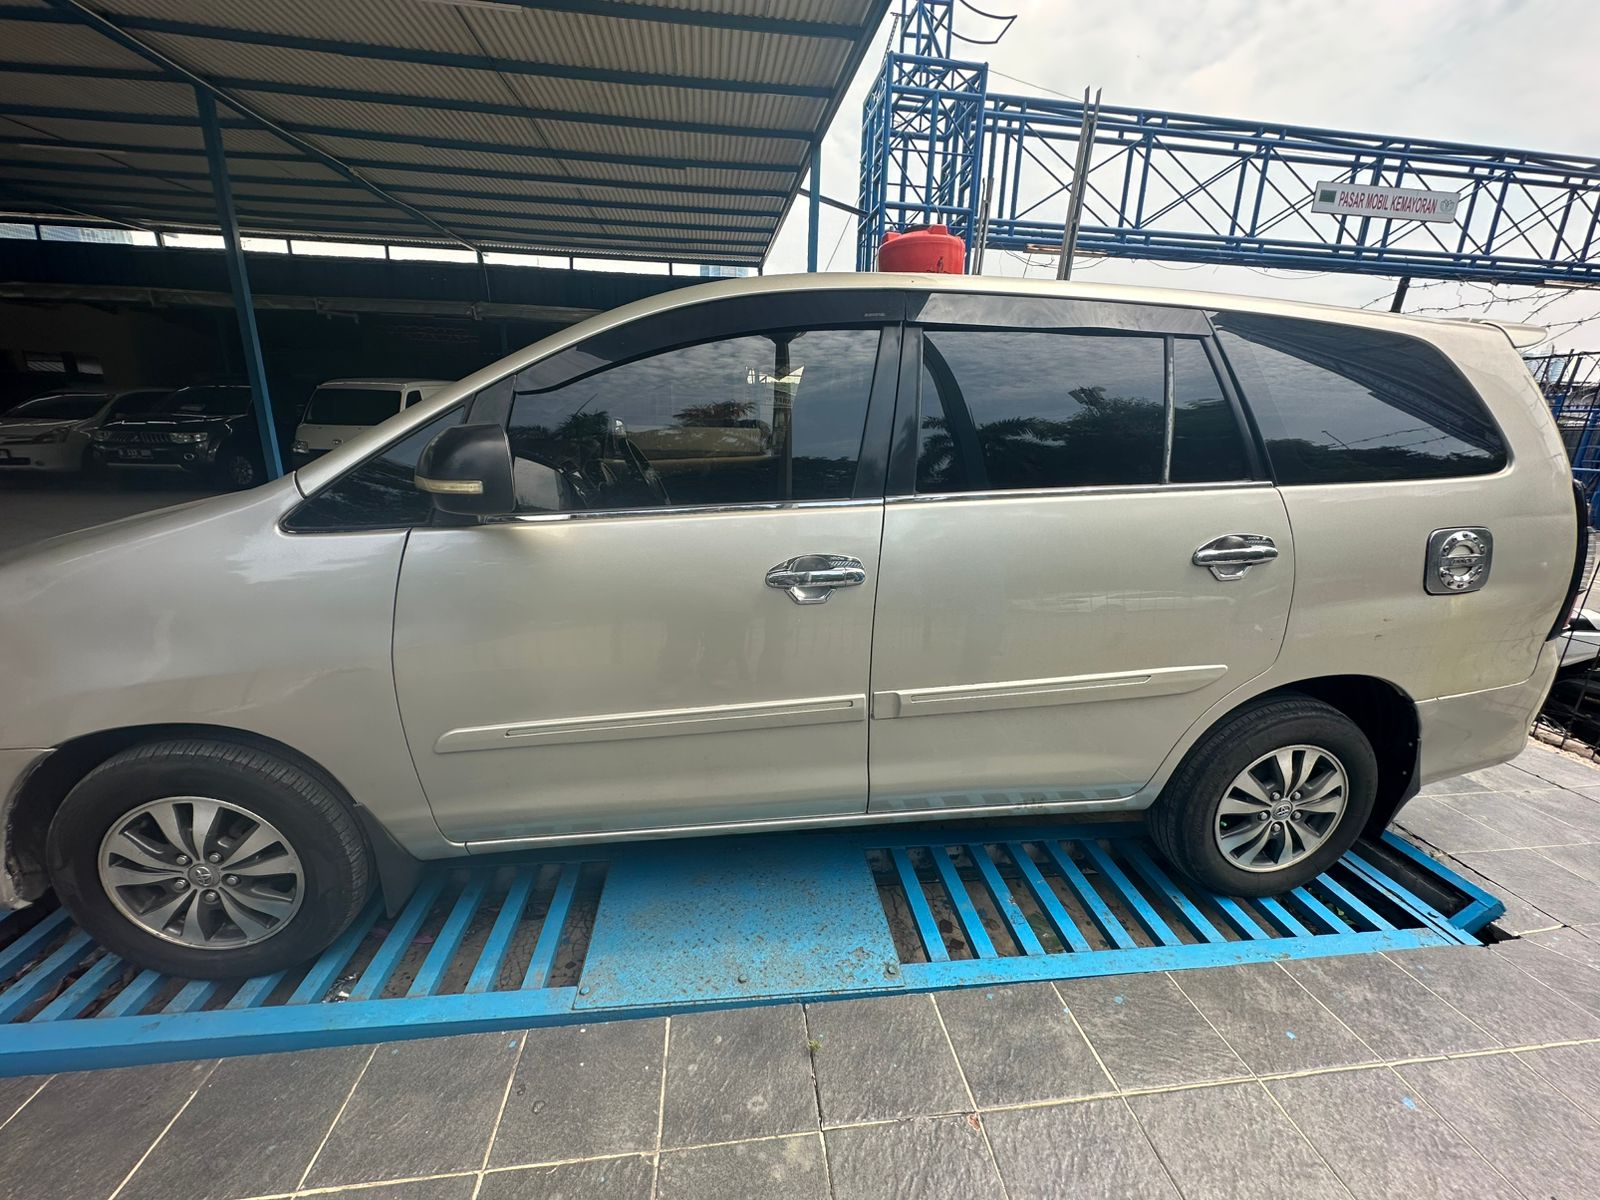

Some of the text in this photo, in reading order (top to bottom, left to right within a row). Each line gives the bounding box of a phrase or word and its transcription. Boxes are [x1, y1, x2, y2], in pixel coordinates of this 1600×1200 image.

[1338, 191, 1438, 214] PASAR MOBIL KEMAYORAN
